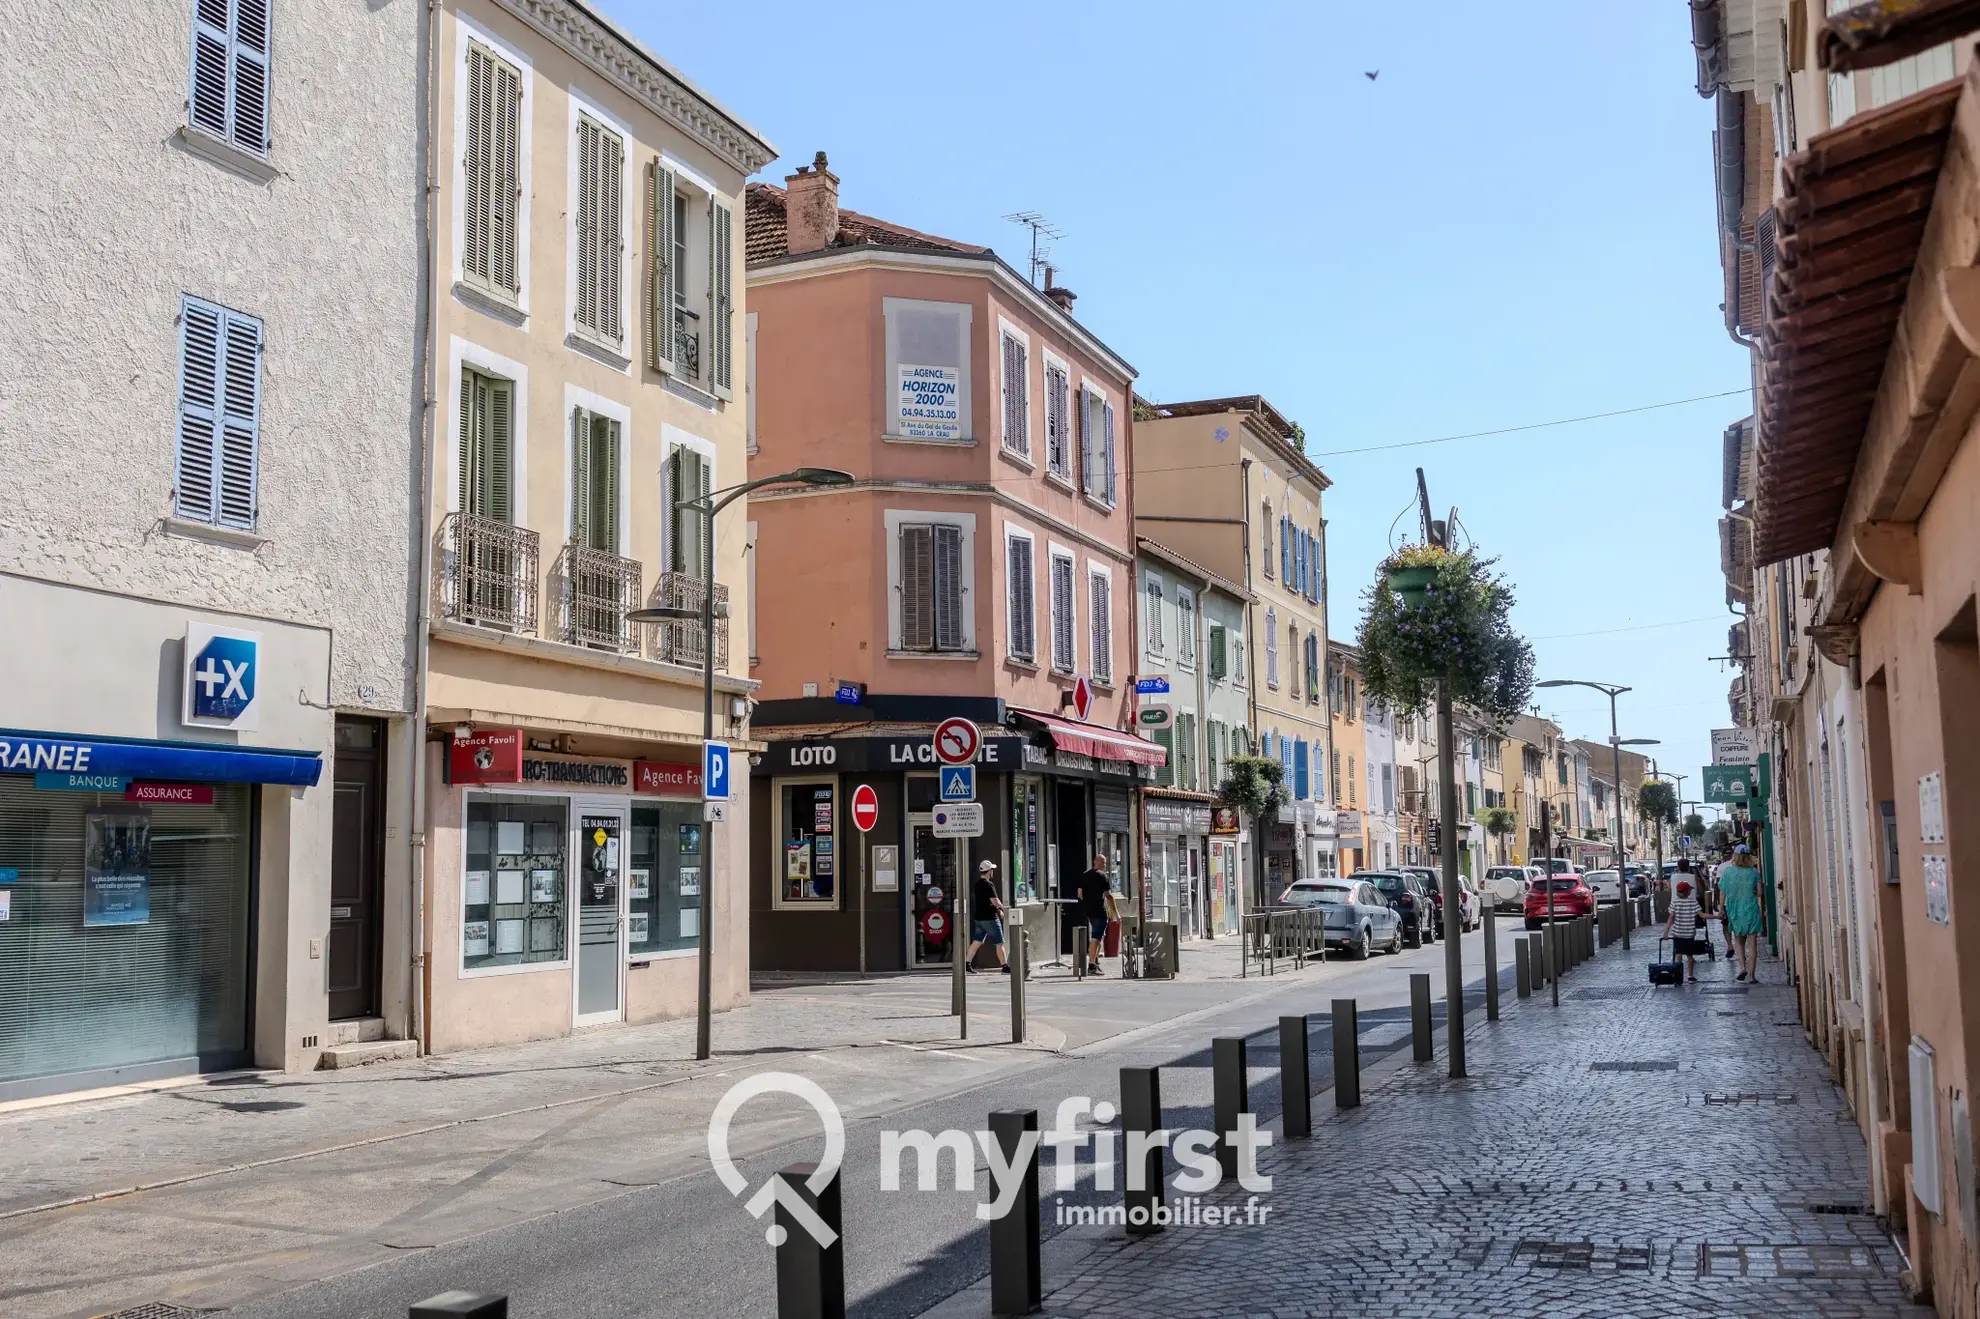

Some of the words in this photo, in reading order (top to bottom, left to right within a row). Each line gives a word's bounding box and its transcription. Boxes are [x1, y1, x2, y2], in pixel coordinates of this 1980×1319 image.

[913, 368, 944, 379] AGENCE
[902, 380, 956, 394] HORIZON
[915, 393, 945, 406] 2000
[901, 407, 957, 420] 04.94.35.13.00
[1139, 680, 1153, 688] FDJ
[841, 687, 851, 697] FDJ
[453, 738, 486, 748] Agence
[488, 735, 515, 745] Favoli
[890, 744, 915, 764] LA
[1023, 744, 1048, 765] TABAC
[1720, 745, 1749, 753] COIFFURE
[790, 745, 837, 767] LOTO
[1719, 755, 1750, 763] Feminin
[69, 775, 118, 788] BANQUE
[643, 767, 683, 787] Agence
[686, 770, 705, 785] Fav
[136, 787, 193, 800] ASSURANCE
